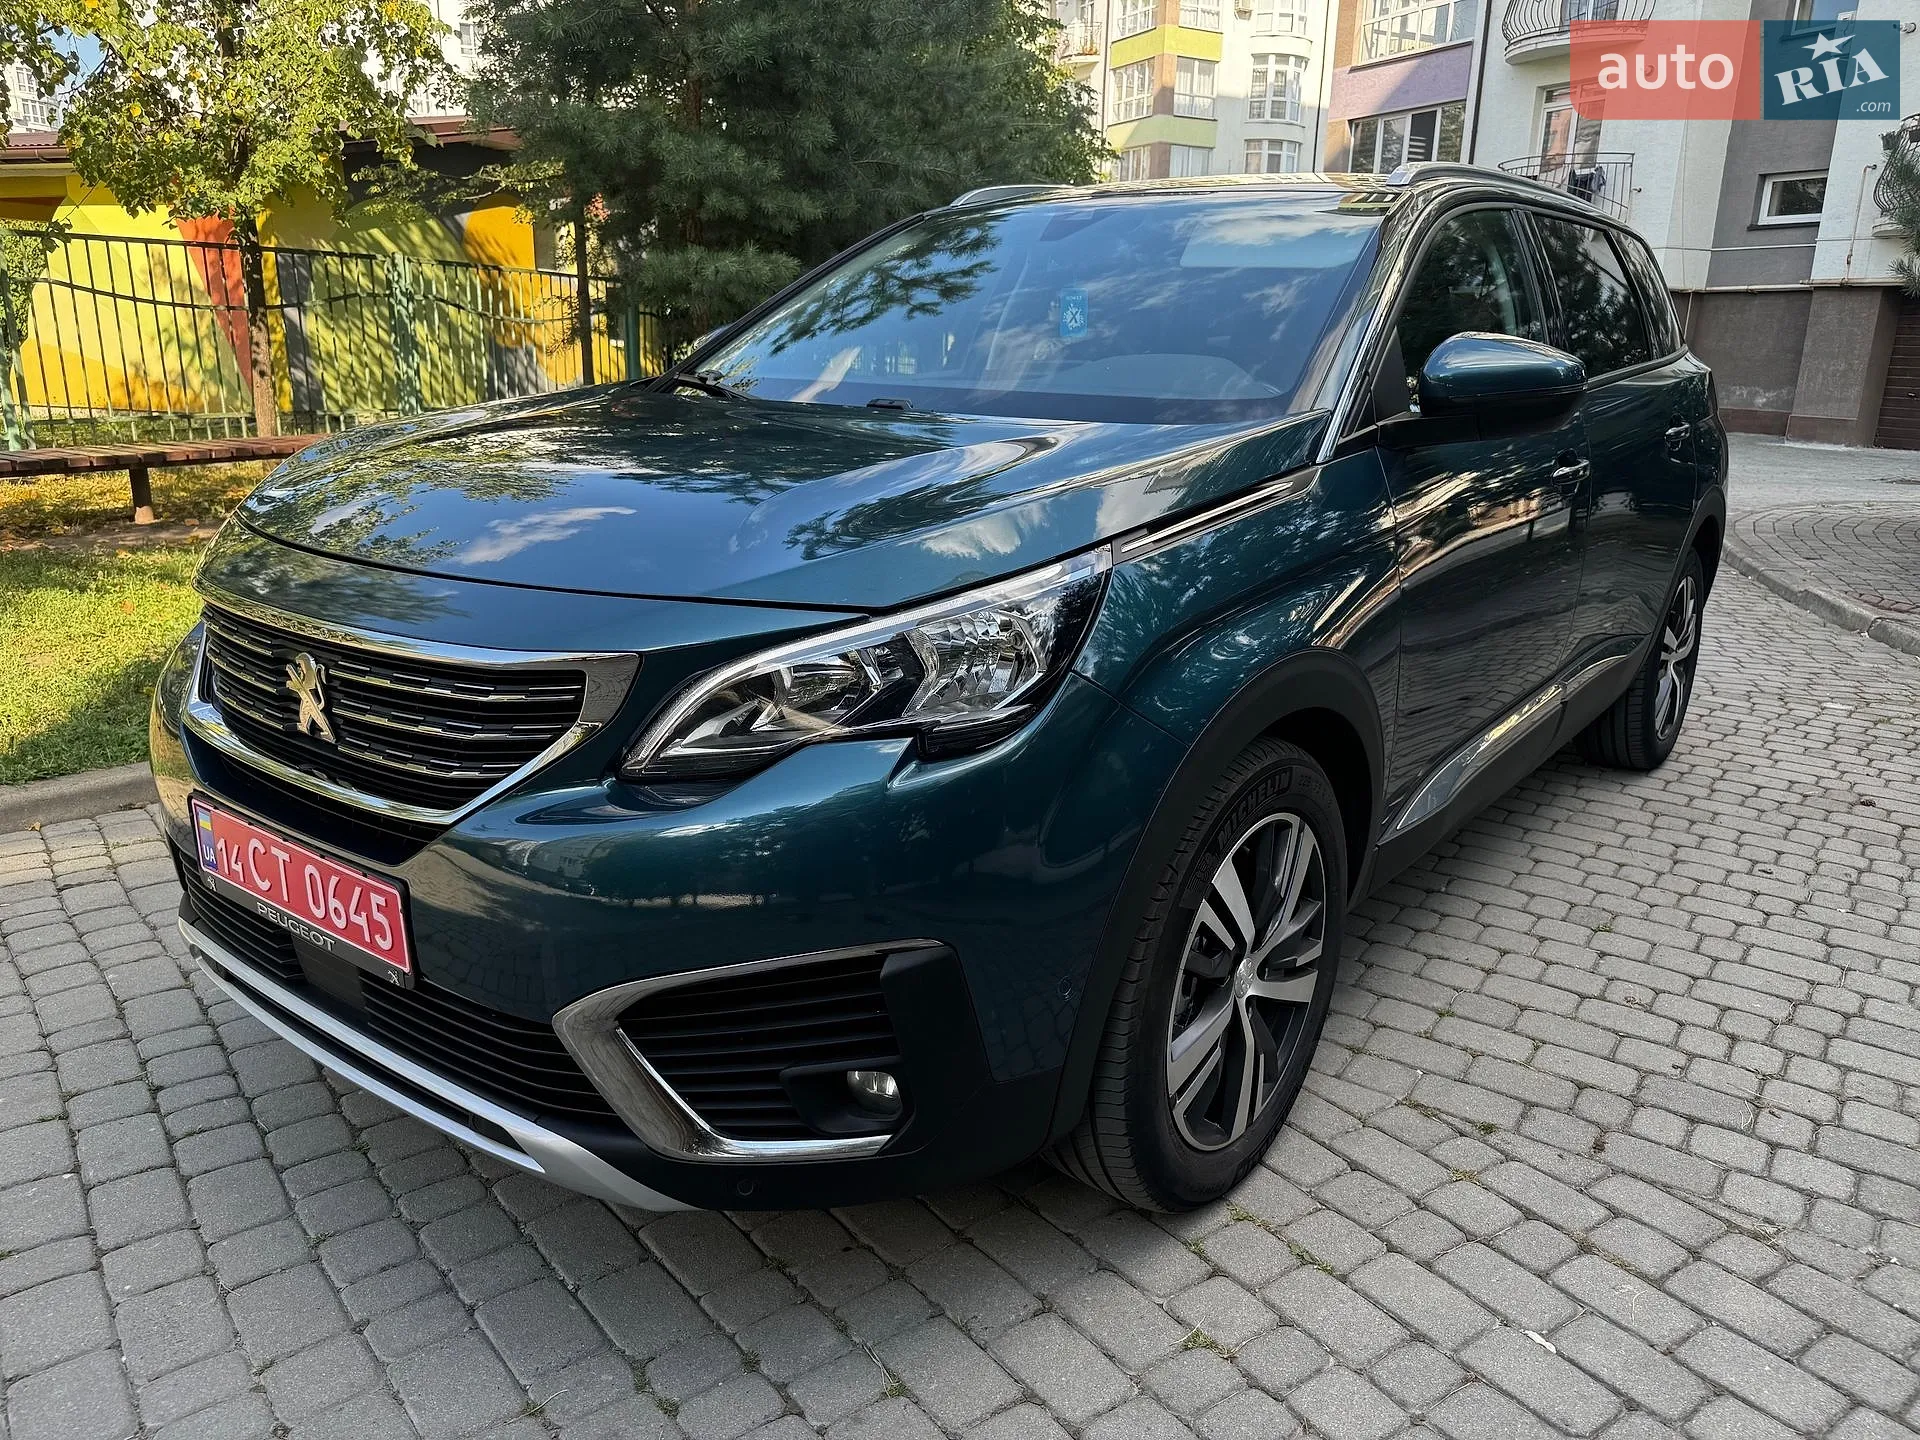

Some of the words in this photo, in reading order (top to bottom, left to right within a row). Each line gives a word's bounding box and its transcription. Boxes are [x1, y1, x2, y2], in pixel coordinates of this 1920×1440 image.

[1216, 769, 1291, 852] MICHELIN
[203, 848, 217, 864] UA
[256, 901, 336, 952] PEUGEOT
[304, 863, 393, 952] 0645
